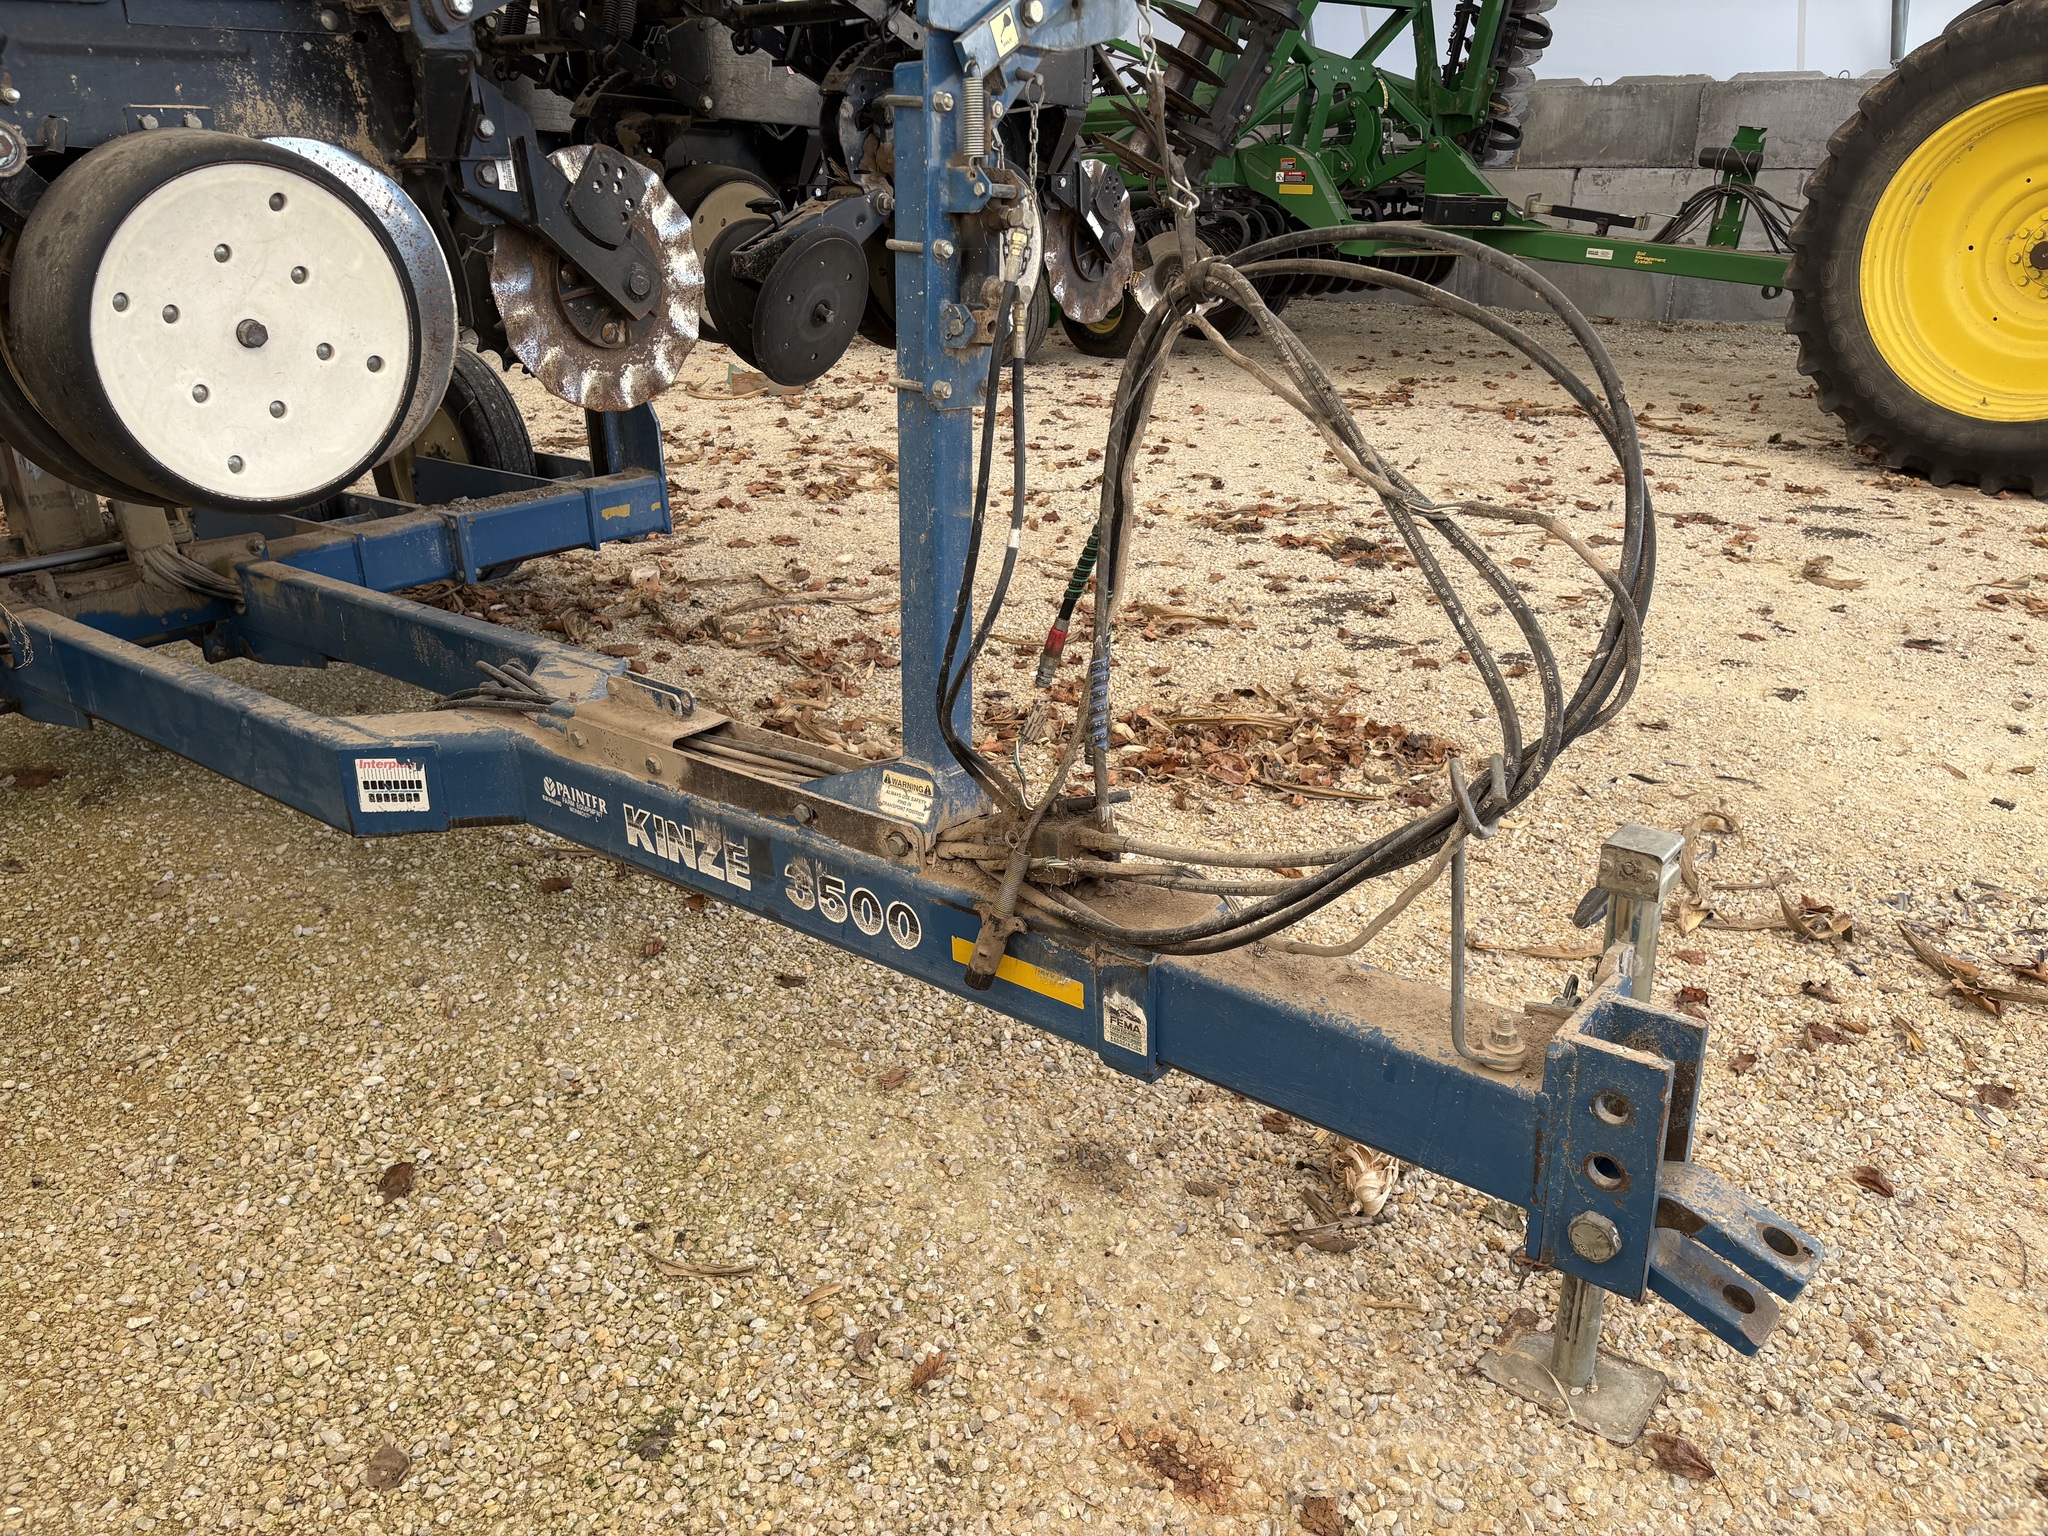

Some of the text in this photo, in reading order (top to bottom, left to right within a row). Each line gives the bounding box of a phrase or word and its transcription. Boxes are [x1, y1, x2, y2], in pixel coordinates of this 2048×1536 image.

[1395, 476, 1413, 494] MSHA
[1405, 529, 1420, 549] MSHA
[1448, 526, 1461, 539] 2SC
[1415, 547, 1426, 559] PSI
[1421, 557, 1434, 573] 4800
[1481, 559, 1495, 573] SAE
[1490, 570, 1515, 596] Products
[1516, 601, 1523, 609] A
[1470, 640, 1482, 655] SAE
[891, 777, 924, 793] WARNING
[1510, 784, 1525, 800] 2SC
[555, 781, 608, 814] PAINTER
[885, 789, 902, 798] ALWAYS
[911, 796, 927, 804] SAFETY
[562, 797, 603, 817] FARM EQUIPMENT
[882, 800, 925, 818] TRANSPORT POSITION
[1473, 798, 1494, 817] SHA
[623, 803, 752, 891] KINZE
[784, 858, 922, 950] 3500
[1110, 1016, 1141, 1034] FEMA
